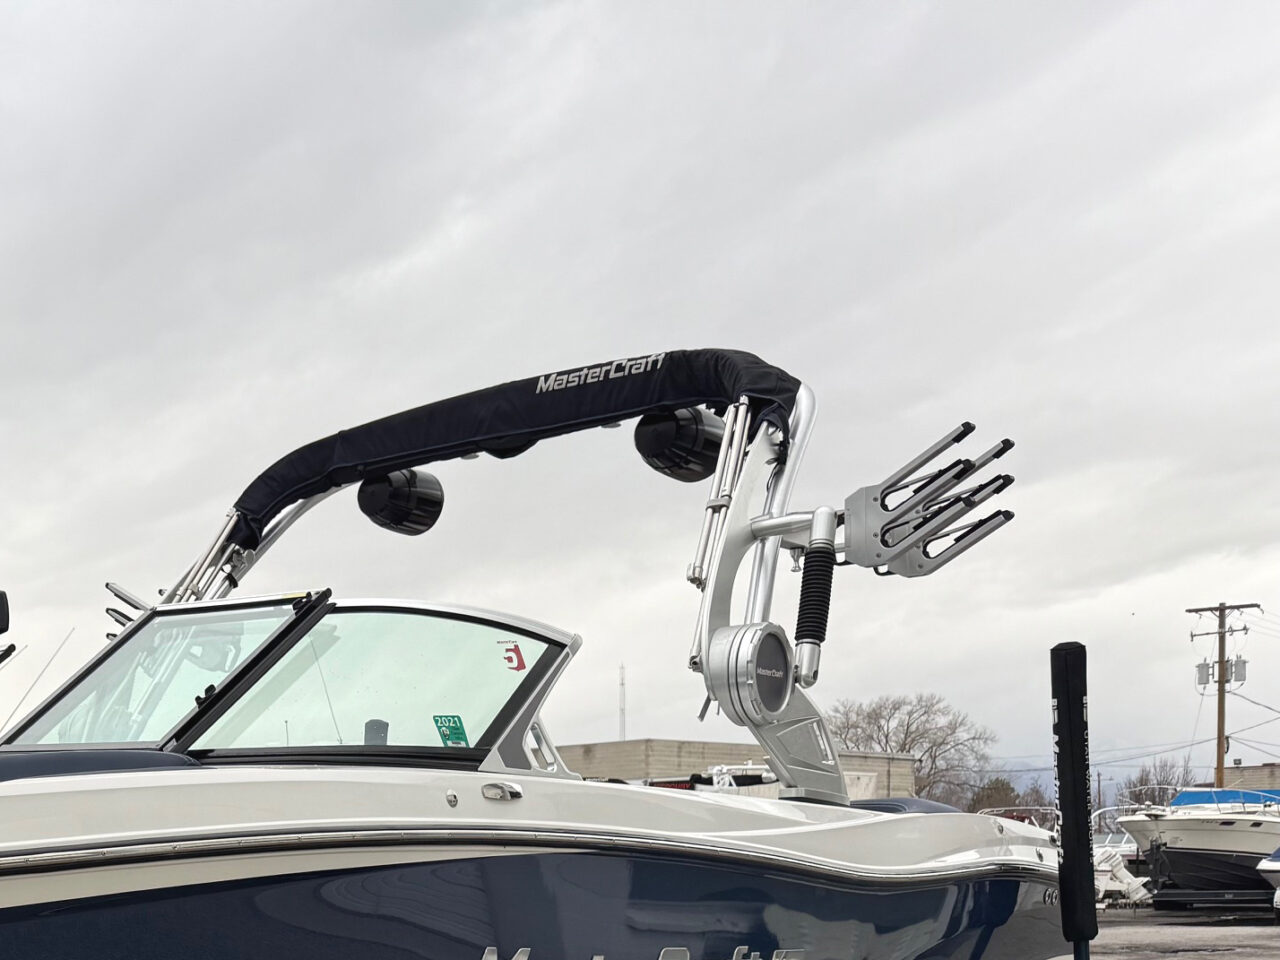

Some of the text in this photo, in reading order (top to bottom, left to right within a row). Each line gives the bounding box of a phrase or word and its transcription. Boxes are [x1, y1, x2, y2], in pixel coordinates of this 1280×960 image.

[536, 352, 666, 395] MasterCraft
[756, 666, 784, 678] MasterCraft
[434, 716, 460, 727] 2021
